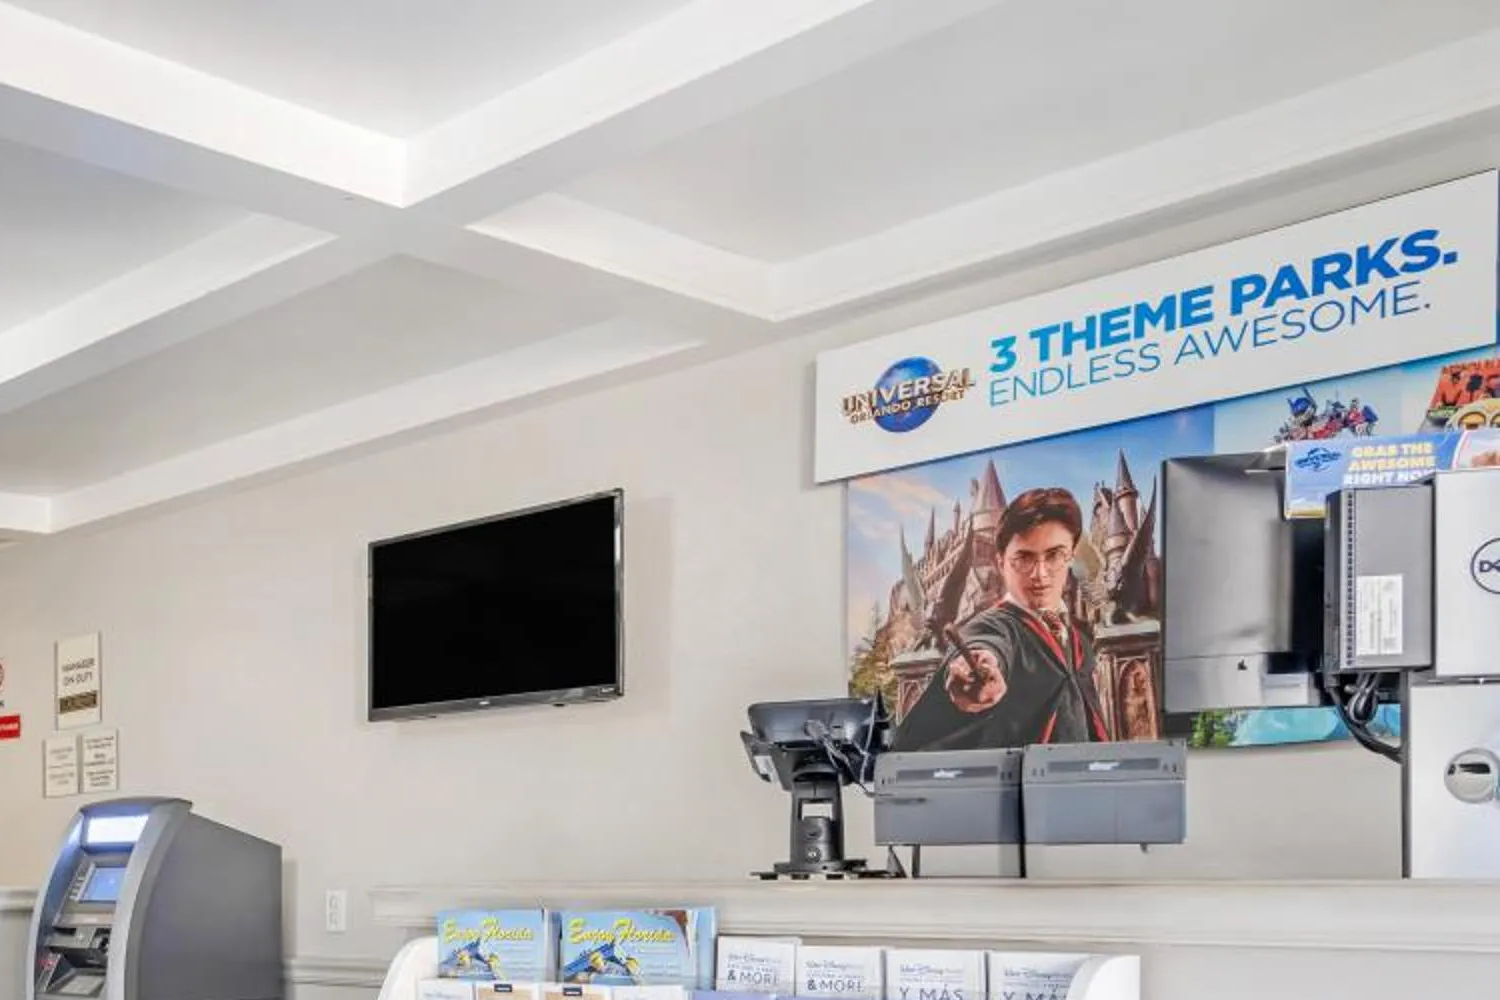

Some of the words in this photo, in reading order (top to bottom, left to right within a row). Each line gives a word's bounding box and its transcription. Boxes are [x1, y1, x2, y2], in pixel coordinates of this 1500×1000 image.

[989, 335, 1017, 372] 3
[1030, 285, 1214, 361] THEME
[1230, 229, 1458, 316] PARKS.
[990, 342, 1161, 406] ENDLESS
[1174, 280, 1431, 364] AWESOME.
[843, 368, 976, 415] UNIVERSAL
[850, 400, 911, 424] ORLANDO
[1351, 444, 1396, 458] GRAB
[1401, 442, 1434, 456] THE
[1348, 456, 1436, 471] AWESOME
[1344, 473, 1392, 486] RIGHT
[739, 971, 780, 985] MORE
[819, 980, 864, 993] MORE
